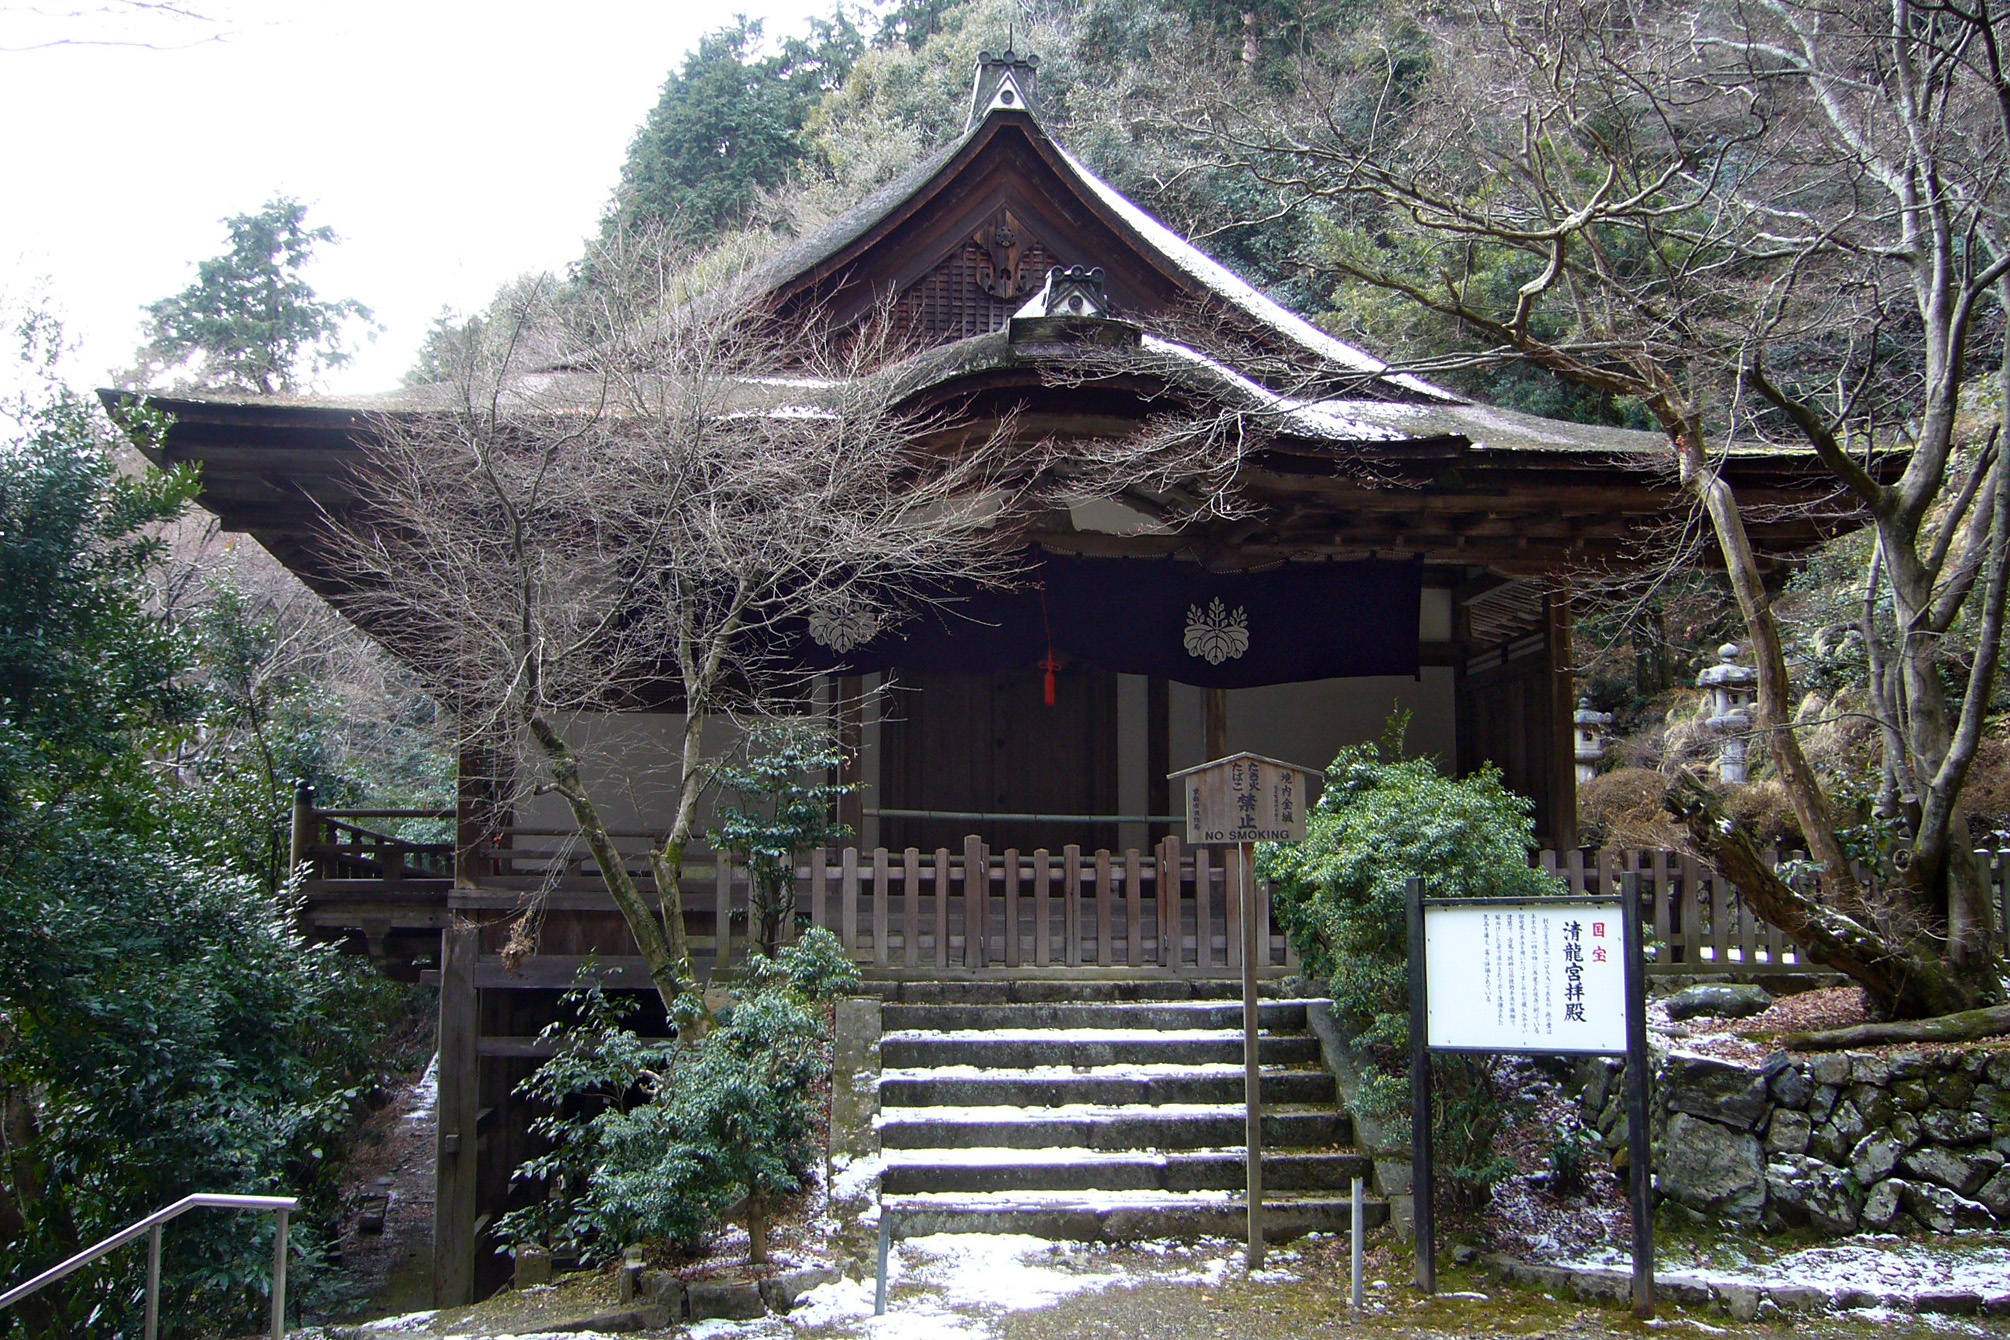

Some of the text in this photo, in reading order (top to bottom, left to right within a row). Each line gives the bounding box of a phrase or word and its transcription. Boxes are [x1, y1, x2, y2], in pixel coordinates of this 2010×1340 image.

[1232, 762, 1244, 791] たばこ
[1248, 762, 1261, 791] たき火
[1237, 793, 1257, 829] 禁止
[1205, 829, 1290, 841] NO SMOKING
[1591, 922, 1607, 963] 国宝
[1562, 920, 1587, 1023] 清龍宮拝殿
